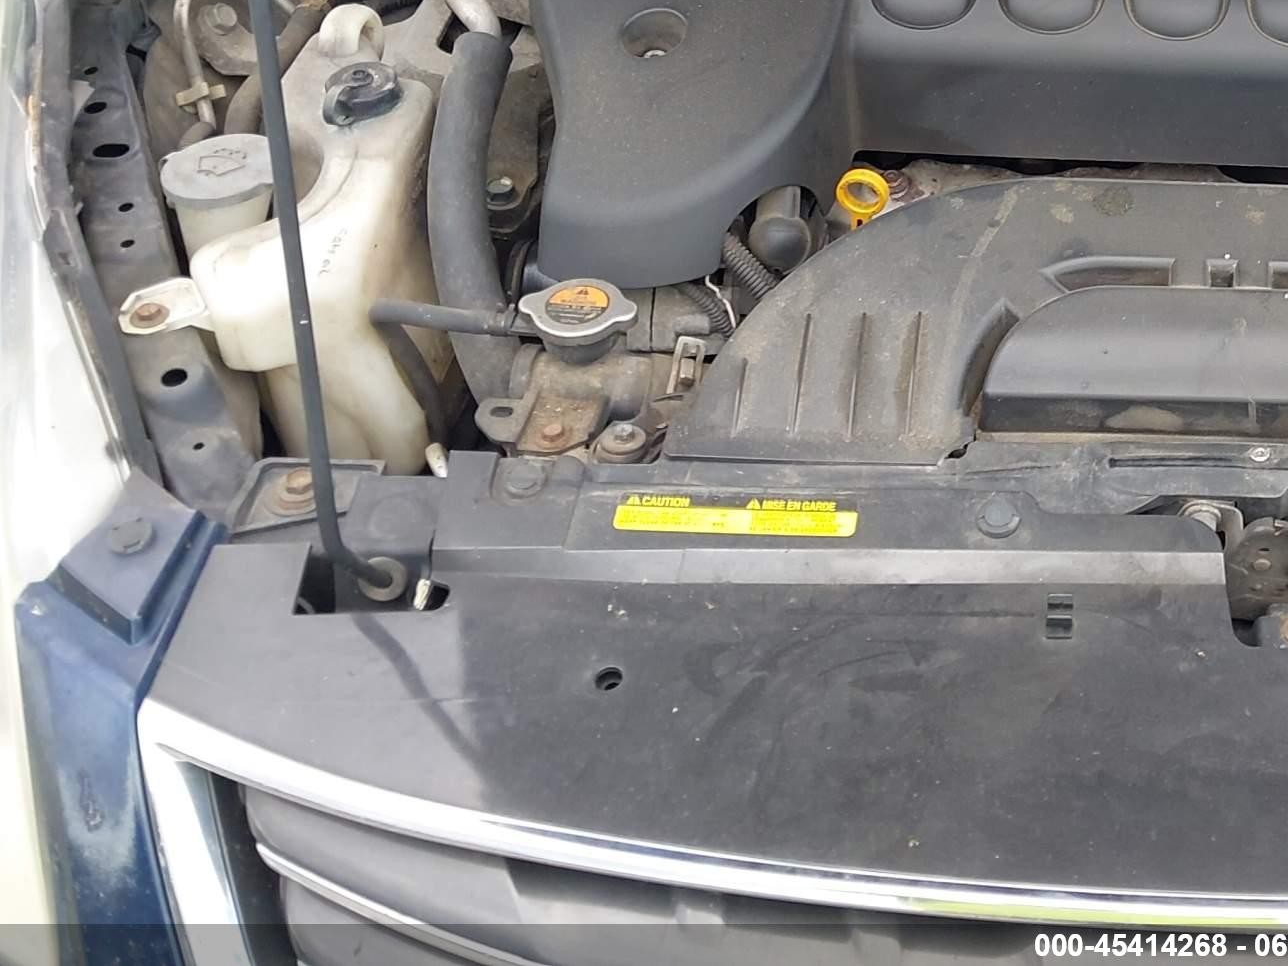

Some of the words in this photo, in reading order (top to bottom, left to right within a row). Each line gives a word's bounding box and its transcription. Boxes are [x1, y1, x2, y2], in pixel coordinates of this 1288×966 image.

[641, 495, 690, 507] CAUTION
[762, 498, 786, 510] MISE
[786, 499, 801, 511] EN
[801, 500, 837, 512] GARDE
